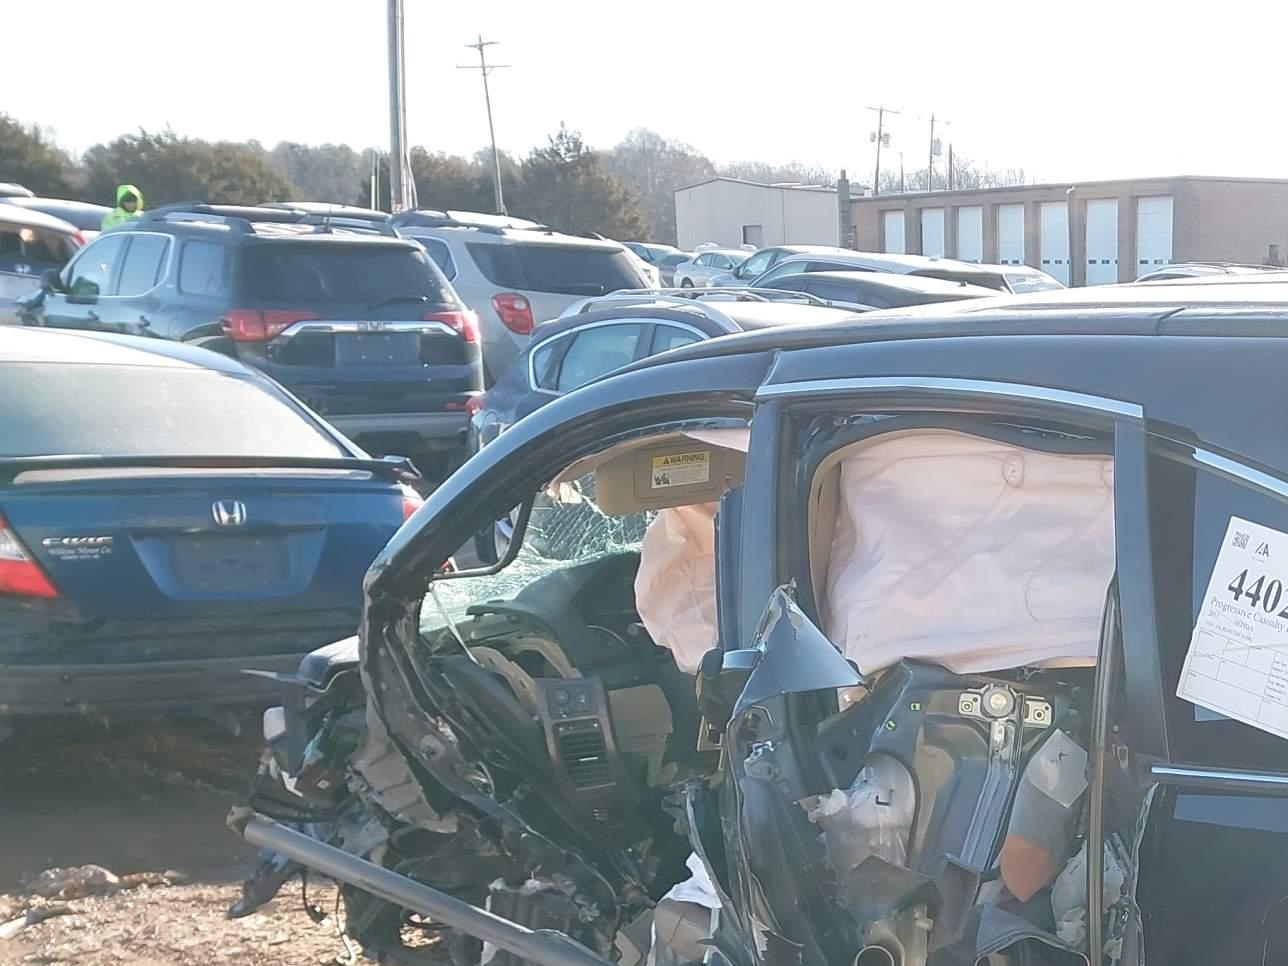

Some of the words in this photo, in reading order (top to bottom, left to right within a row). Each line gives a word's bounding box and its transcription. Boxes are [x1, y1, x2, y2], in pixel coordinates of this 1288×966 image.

[671, 453, 704, 463] WARNING
[42, 536, 113, 546] CIVIC
[1210, 596, 1252, 620] Progressive
[1253, 612, 1286, 633] Casualty
